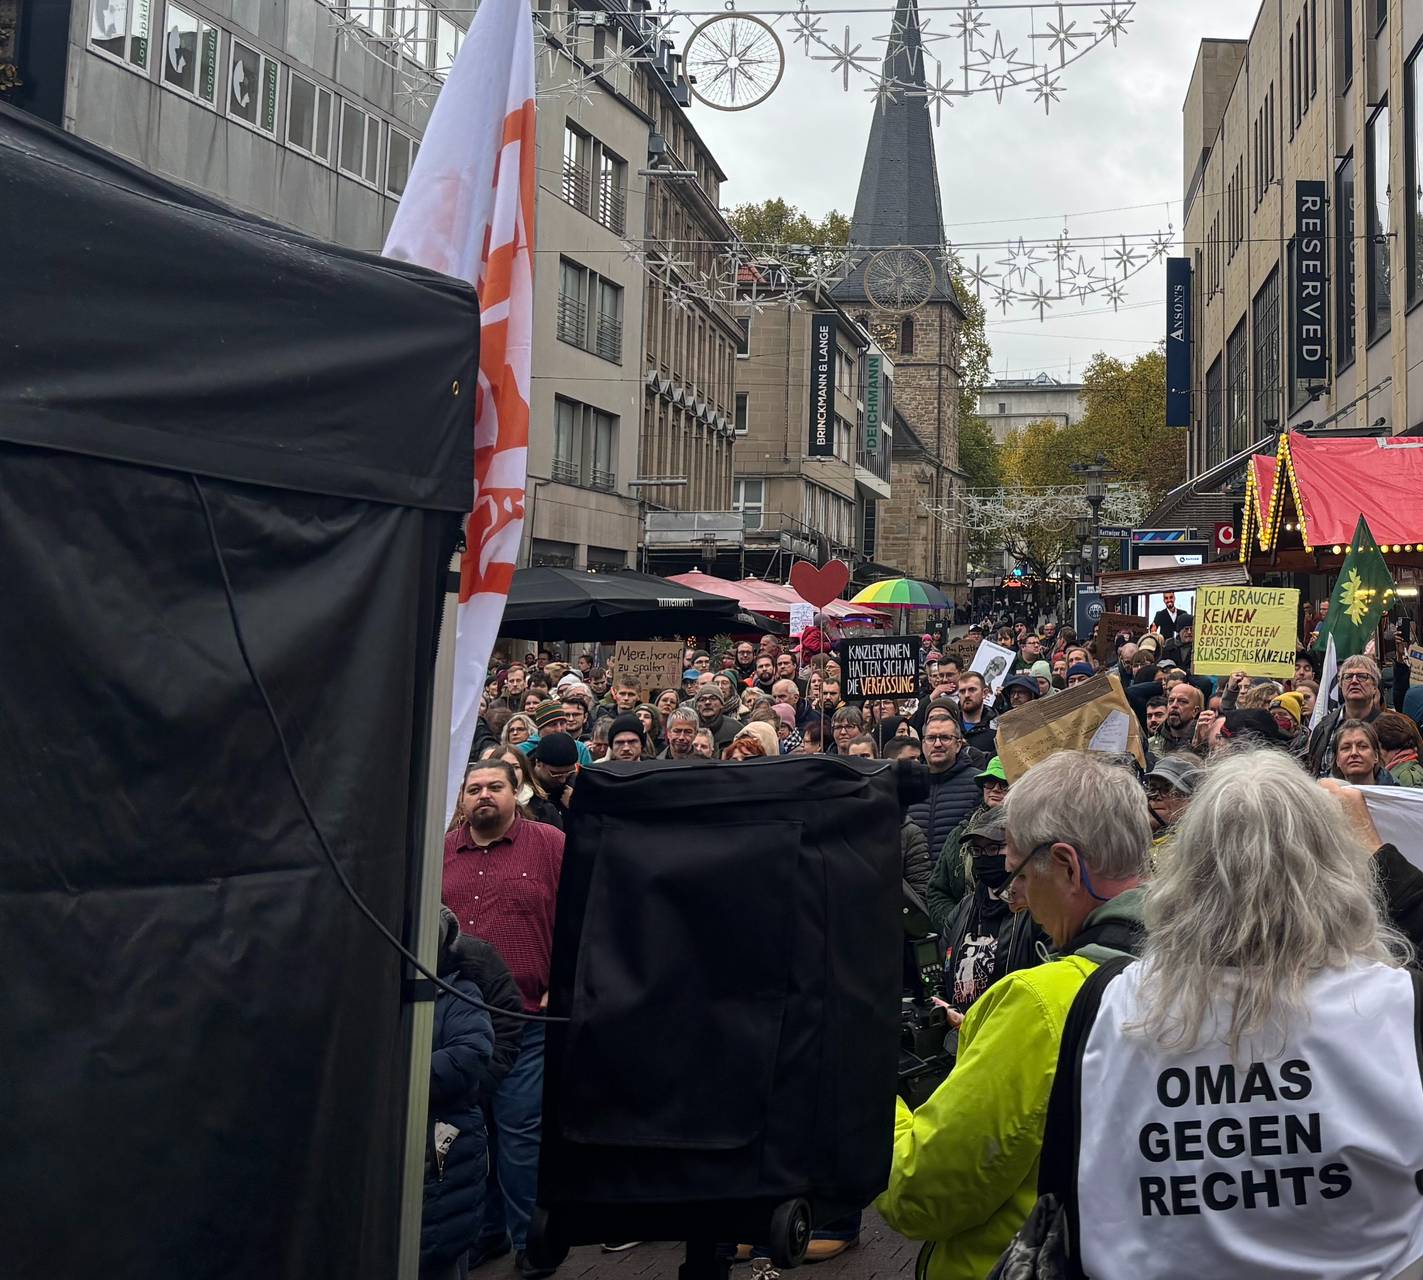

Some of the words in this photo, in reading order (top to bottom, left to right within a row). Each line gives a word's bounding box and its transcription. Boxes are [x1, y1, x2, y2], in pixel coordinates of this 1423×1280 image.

[266, 63, 276, 130] Logopädie
[1302, 195, 1321, 362] RESERVED
[819, 325, 829, 362] LANGE
[816, 373, 827, 446] BRINCKMANN
[867, 357, 879, 449] DEICHMANN
[1204, 590, 1225, 607] ICH
[1229, 589, 1286, 606] BRAUCHE
[618, 645, 649, 662] Merz,
[618, 663, 629, 673] zu
[848, 660, 880, 678] HALTEN
[882, 660, 902, 677] SICH
[902, 659, 915, 675] AN
[1254, 648, 1295, 666] KANZLER
[847, 678, 860, 696] DIE
[860, 675, 914, 696] VERFASSUNG
[1156, 1059, 1313, 1108] OMAS
[1138, 1112, 1322, 1163] GEGEN
[1139, 1162, 1352, 1217] RECHTS
